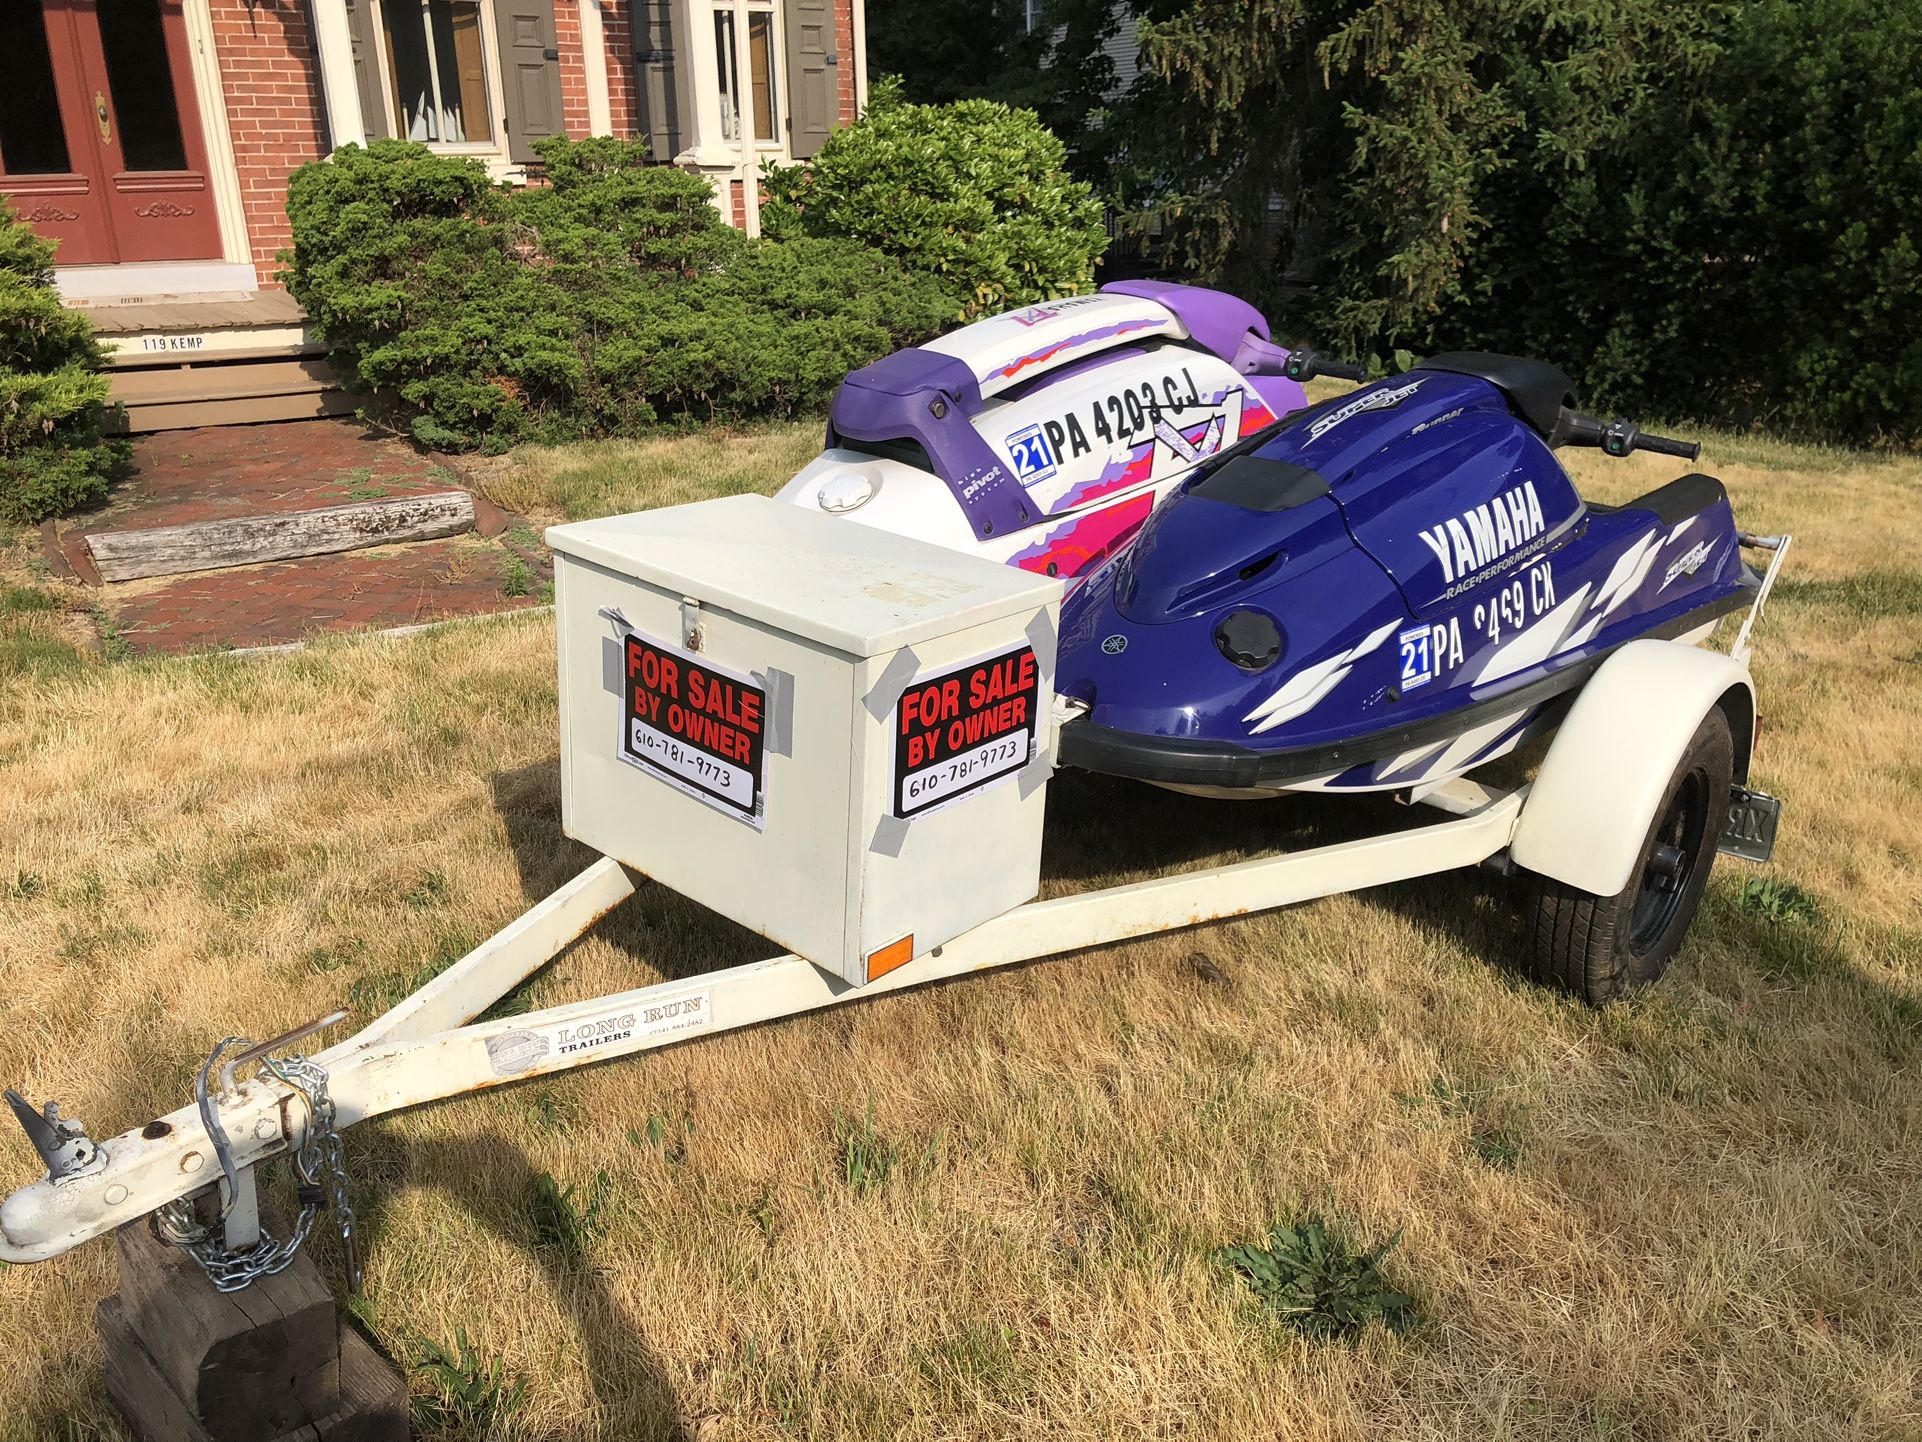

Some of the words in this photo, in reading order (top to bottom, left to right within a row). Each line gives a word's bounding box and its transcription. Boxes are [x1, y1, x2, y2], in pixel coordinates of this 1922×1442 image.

[143, 338, 167, 351] 119
[170, 337, 203, 350] KEMP
[1043, 411, 1092, 466] PA
[1092, 381, 1162, 445] 4203
[1162, 367, 1200, 415] CJ
[1310, 387, 1390, 439] SUPER
[1382, 384, 1419, 407] JET
[962, 465, 1002, 500] pivot
[1011, 435, 1050, 477] 21
[1418, 480, 1545, 584] YAMAHA
[1433, 616, 1464, 678] PA
[1531, 560, 1556, 616] CX
[1401, 636, 1429, 680] 21
[628, 641, 679, 700] FOR
[687, 669, 760, 734] SALE
[901, 679, 961, 736] FOR
[969, 651, 1036, 710] SALE
[634, 685, 661, 722] BY
[667, 703, 751, 765] OWNER
[907, 727, 941, 768] BY
[947, 696, 1027, 751] OWNER
[635, 729, 731, 788] 610-781-9773
[909, 740, 1017, 798] 610-781-9773
[558, 1013, 636, 1045] LONG
[643, 996, 703, 1024] RUN
[558, 1030, 632, 1055] TRAILERS
